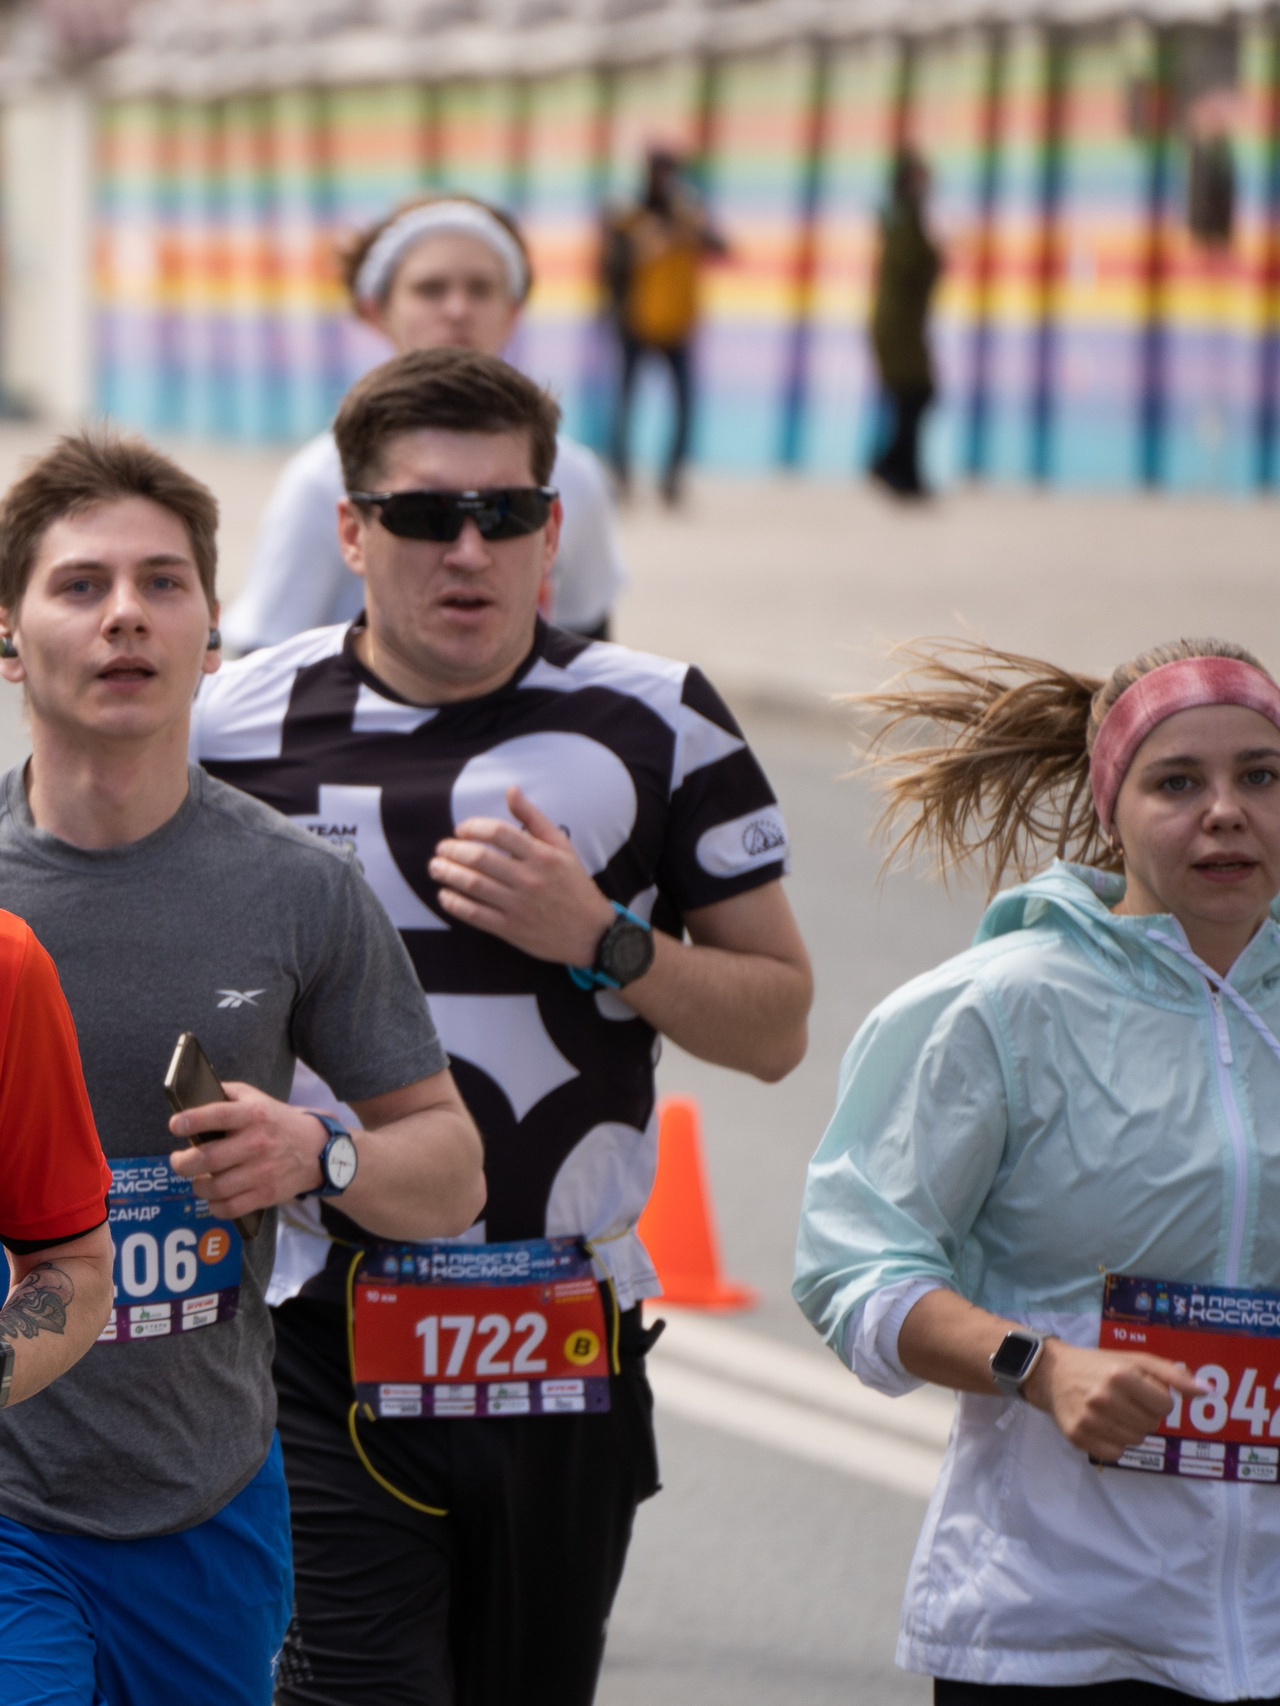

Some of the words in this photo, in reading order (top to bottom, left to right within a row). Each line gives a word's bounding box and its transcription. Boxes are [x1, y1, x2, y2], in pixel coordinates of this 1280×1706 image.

[307, 823, 357, 836] TEAM
[111, 1167, 168, 1182] ОСТО
[108, 1206, 160, 1221] САНДР
[113, 1228, 197, 1298] 06
[452, 1251, 530, 1266] ПРОСТО
[432, 1263, 530, 1279] КОСМОС
[1189, 1308, 1280, 1327] КОСМО
[1113, 1328, 1127, 1340] 10
[415, 1312, 548, 1376] 1722
